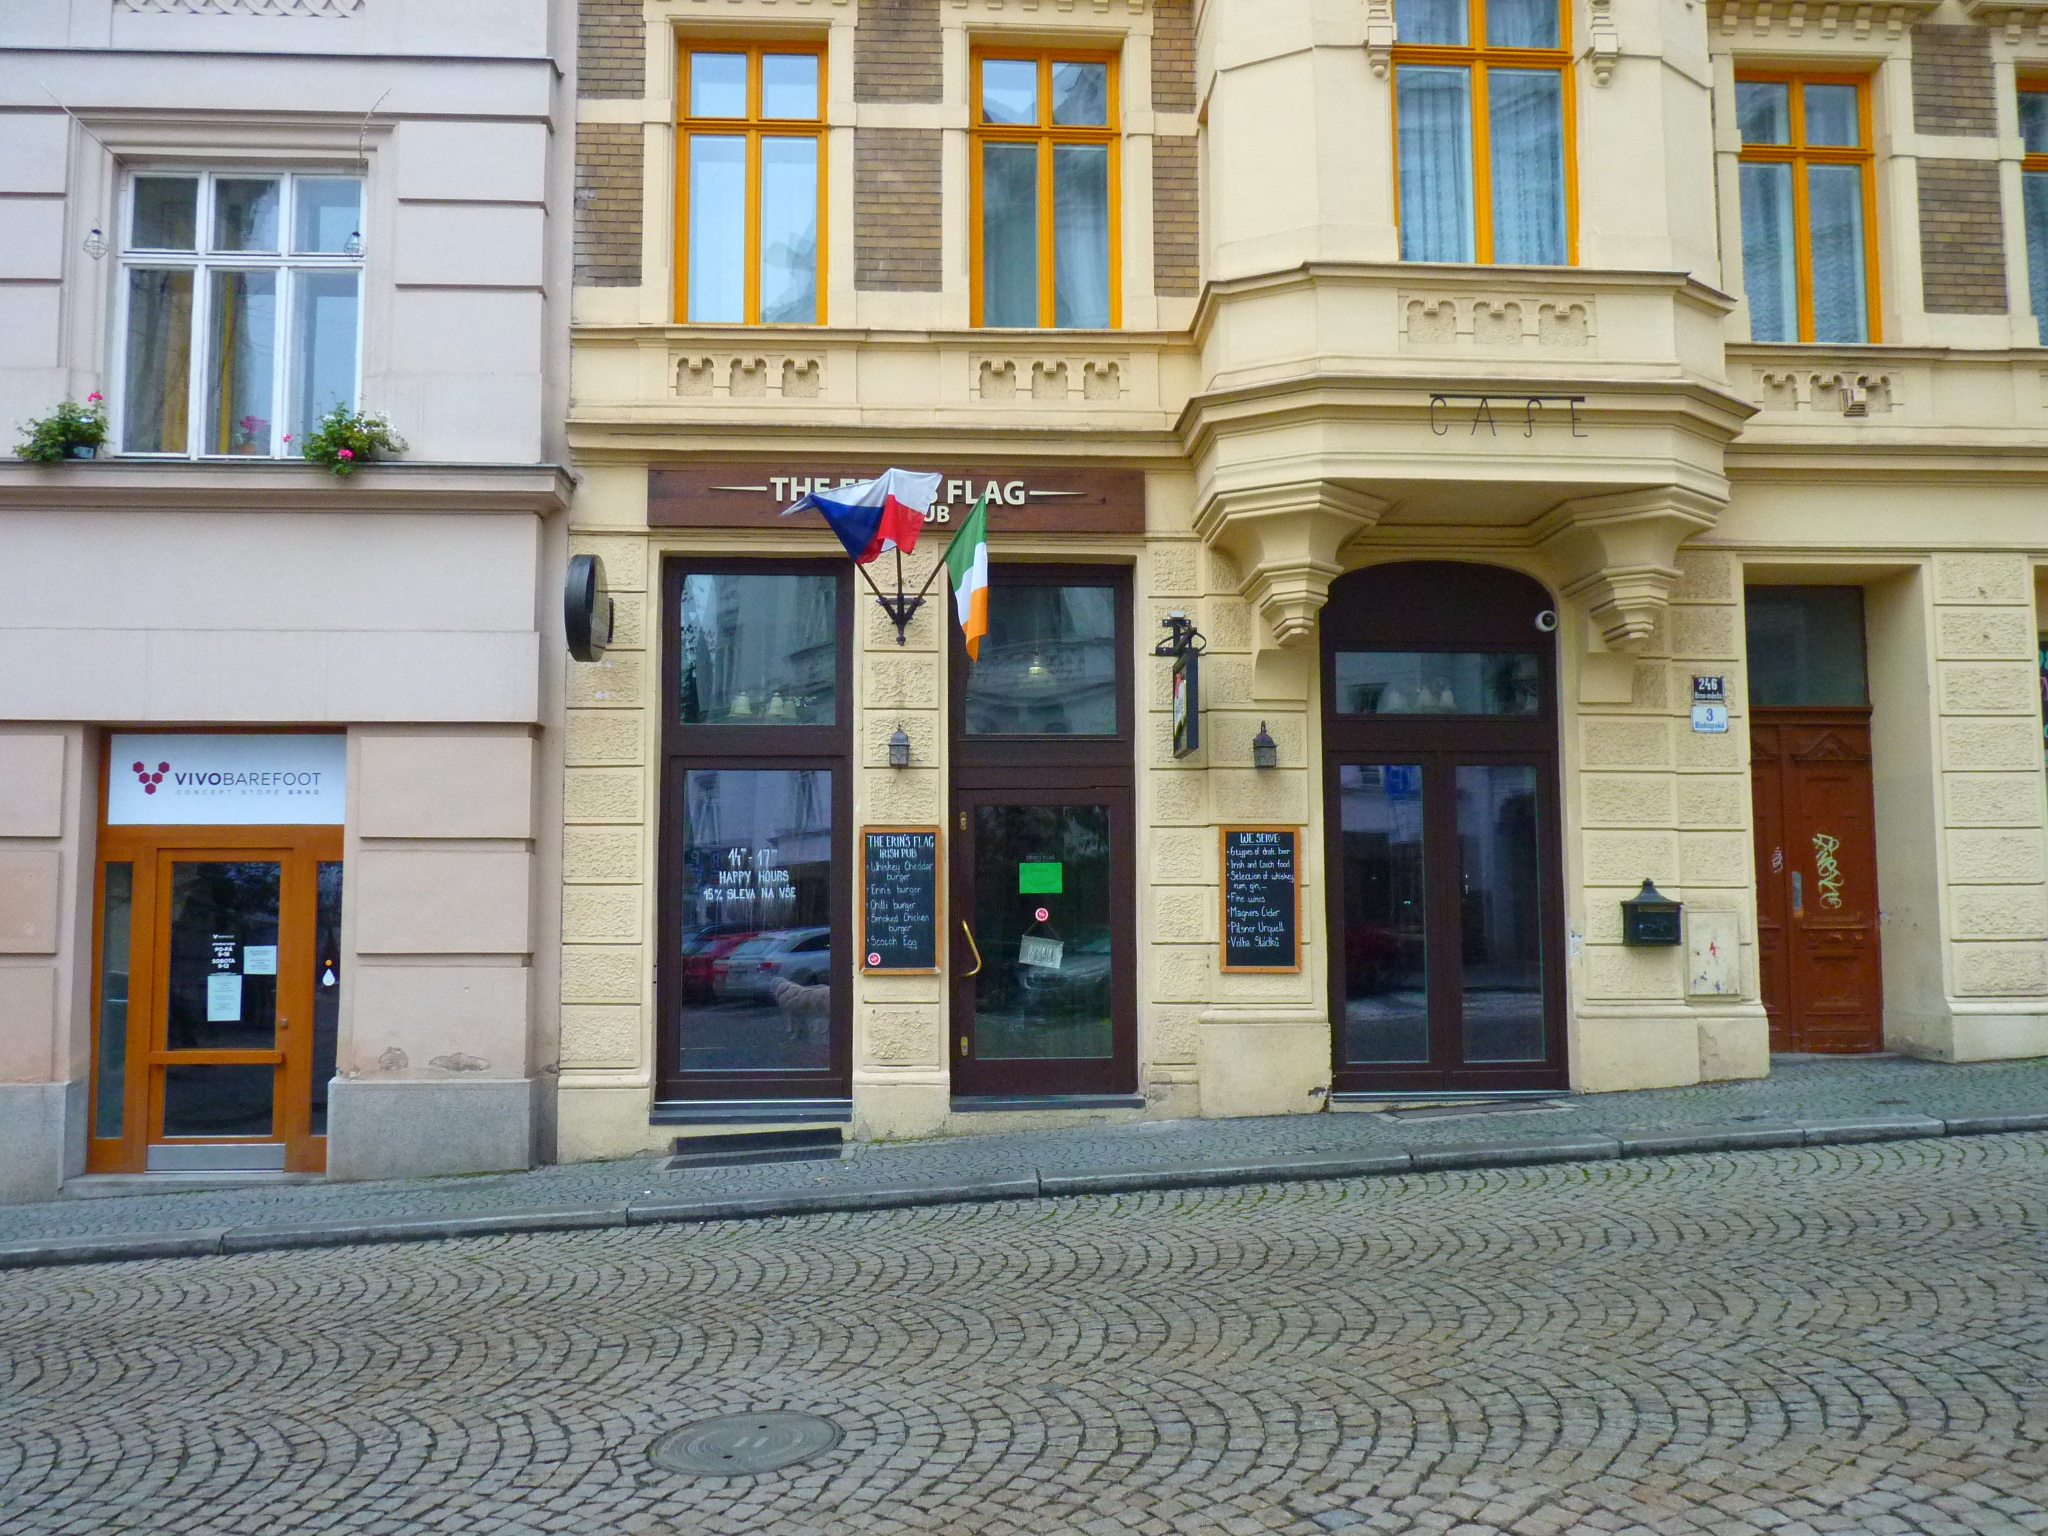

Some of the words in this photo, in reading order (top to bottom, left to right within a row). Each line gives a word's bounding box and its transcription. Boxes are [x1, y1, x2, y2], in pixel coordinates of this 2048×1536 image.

[1430, 396, 1588, 438] CAFE
[947, 480, 1025, 505] FLAG
[1698, 677, 1718, 691] 246
[1706, 708, 1714, 722] 3
[174, 771, 322, 786] VIVOBAREFOOT
[867, 835, 884, 848] THE
[886, 834, 911, 848] ERIN'S
[913, 835, 934, 849] FLAG
[1240, 832, 1254, 844] WE
[879, 848, 899, 859] IRISH
[901, 848, 918, 859] PUB
[1247, 859, 1258, 869] and
[1277, 859, 1291, 868] food
[719, 870, 751, 884] HAPPY
[757, 870, 789, 883] HOURS
[886, 873, 911, 882] burger
[1230, 870, 1262, 881] Selection
[703, 887, 723, 901] 15%
[726, 887, 756, 900] SLEVA
[761, 887, 775, 899] NA
[778, 884, 797, 899] VŠE
[896, 884, 921, 897] burger
[1230, 892, 1245, 903] Fine
[892, 899, 916, 911] burger
[1261, 906, 1281, 917] Cider
[888, 924, 912, 935] burger
[1257, 921, 1285, 936] Urquell
[870, 934, 898, 947] Scotch
[902, 934, 918, 950] Egg
